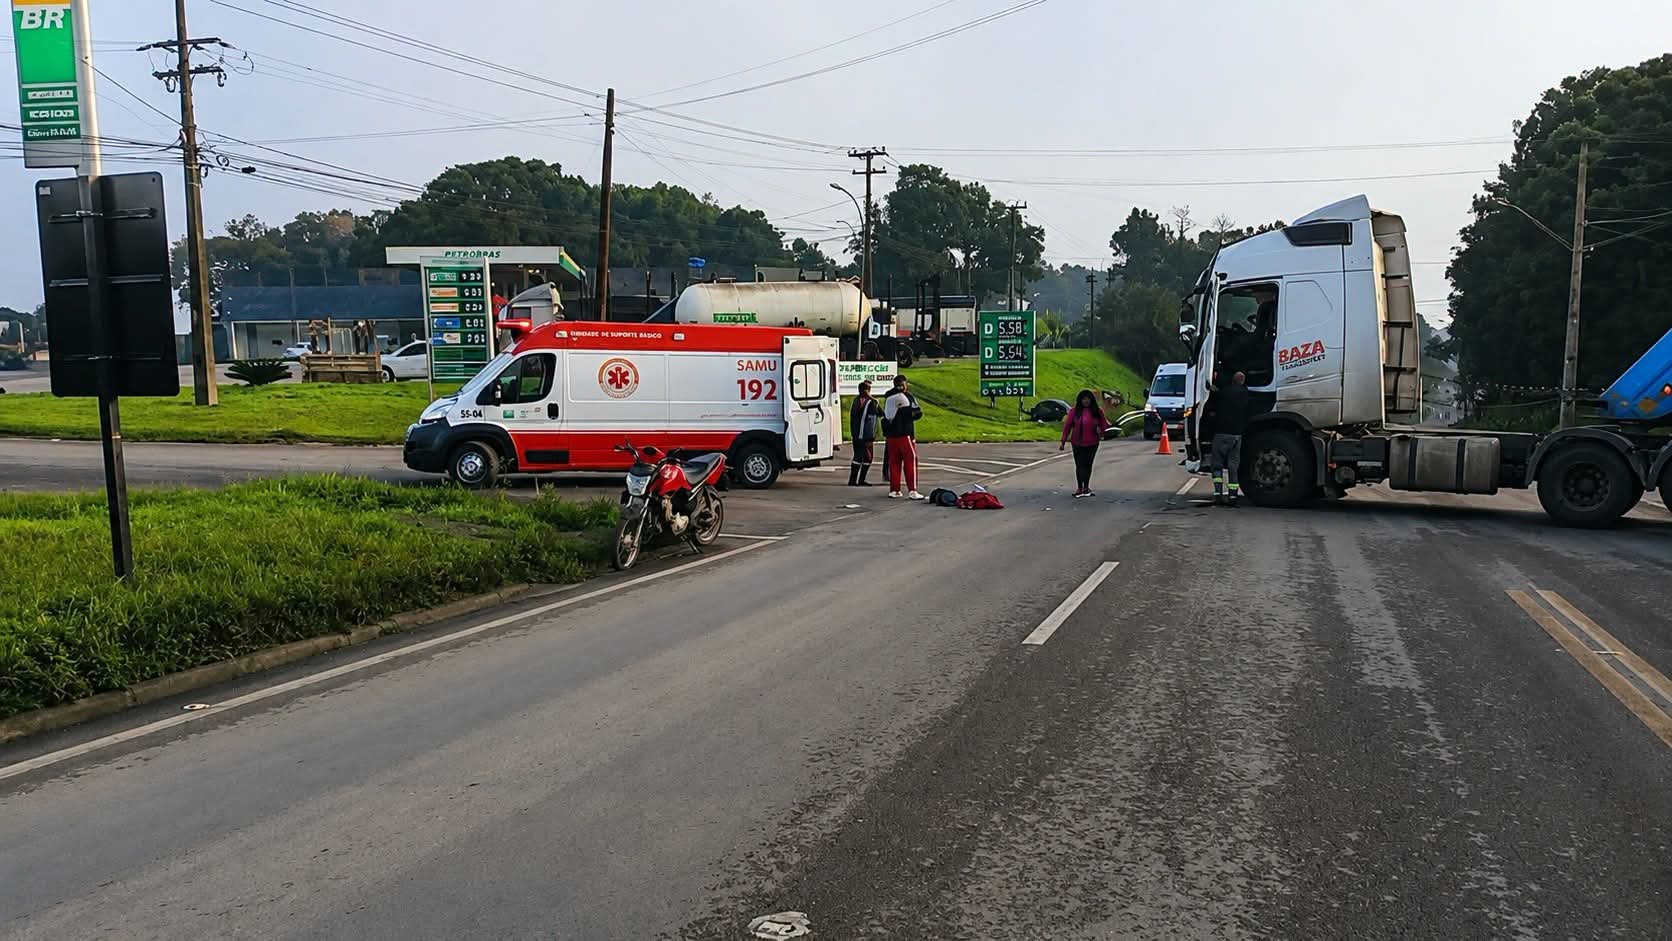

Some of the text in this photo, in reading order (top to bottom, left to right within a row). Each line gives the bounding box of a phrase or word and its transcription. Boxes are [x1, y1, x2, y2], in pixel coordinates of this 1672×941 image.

[20, 8, 64, 29] BR
[445, 250, 501, 258] PETROBRAS
[984, 321, 1022, 335] D 5.58
[984, 345, 1022, 359] D 5.54
[1279, 340, 1325, 363] BAZA
[737, 359, 777, 372] SAMU
[736, 379, 777, 400] 192
